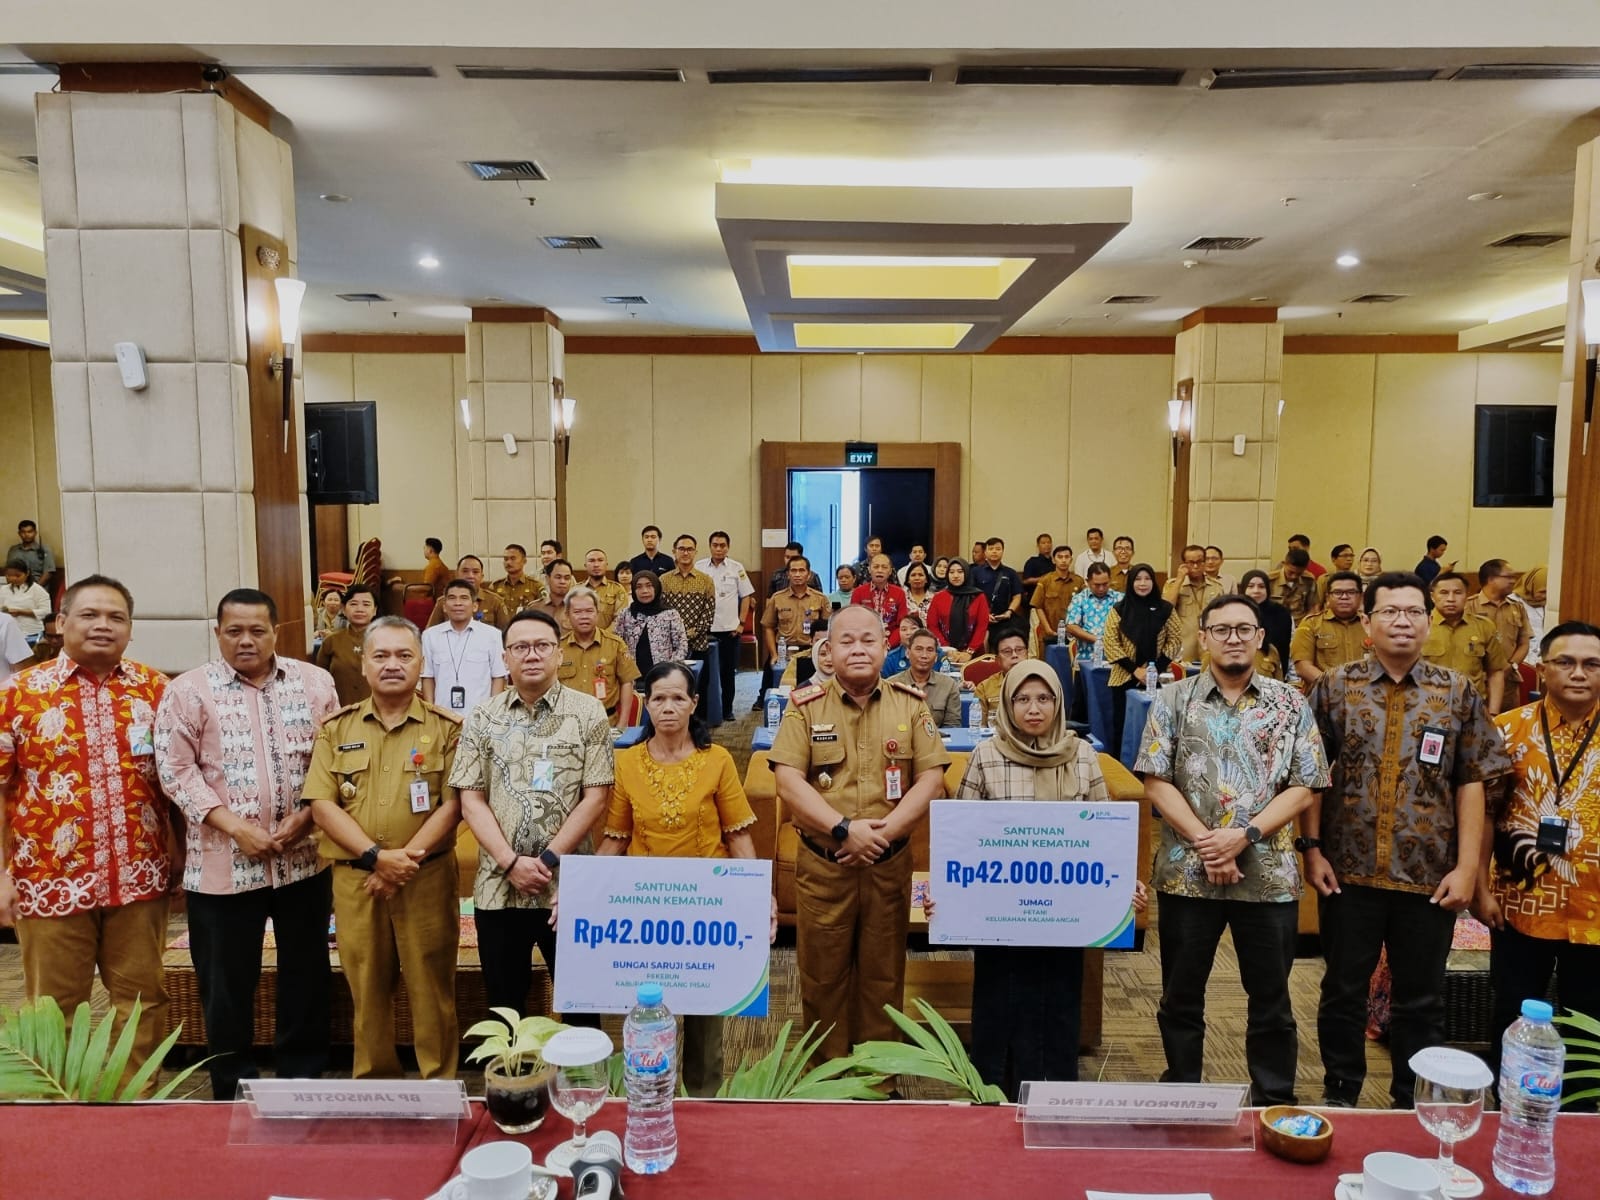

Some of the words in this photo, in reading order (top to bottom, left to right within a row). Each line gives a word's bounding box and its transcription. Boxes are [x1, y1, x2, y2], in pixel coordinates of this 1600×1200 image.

[850, 454, 872, 463] EXIT
[1003, 826, 1065, 836] SANTUNAN
[978, 839, 1029, 848] JAMINAN
[1032, 839, 1090, 848] KEMATIAN
[946, 860, 1119, 888] Rp42.000.000,-
[634, 882, 698, 893] SANTUNAN
[608, 895, 661, 905] JAMINAN
[663, 896, 723, 906] KEMATIAN
[574, 918, 753, 950] Rp42.000.000,-
[612, 960, 649, 969] BUNGAI
[651, 961, 683, 970] SARUJI
[685, 961, 715, 971] SALEH
[631, 1049, 663, 1069] Club
